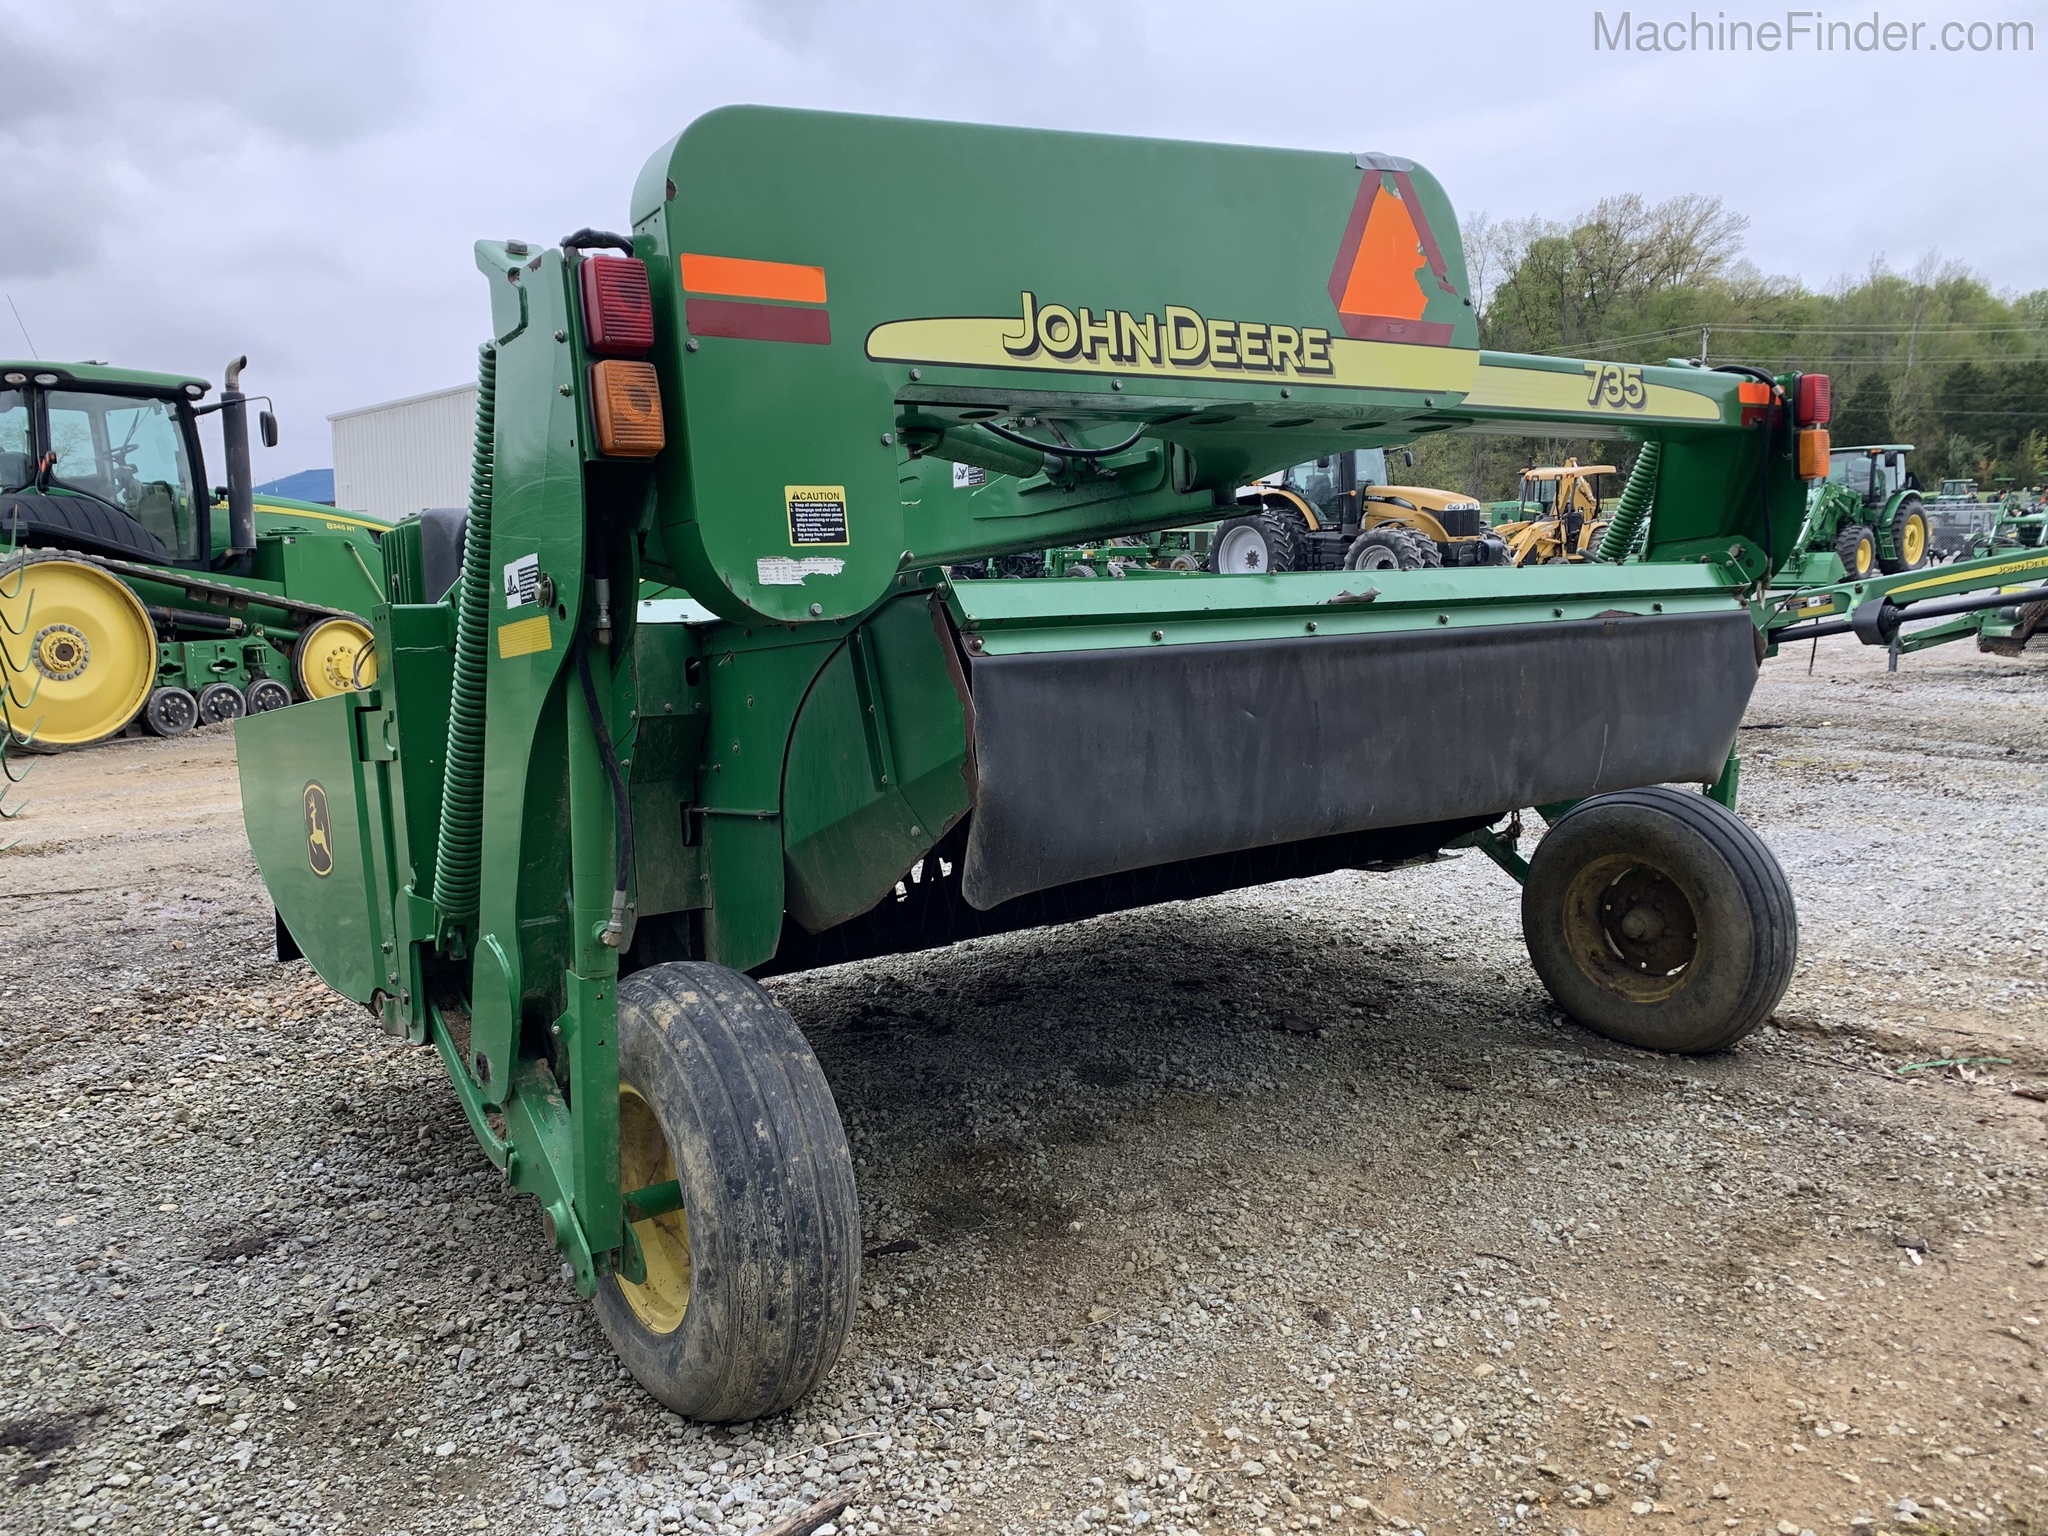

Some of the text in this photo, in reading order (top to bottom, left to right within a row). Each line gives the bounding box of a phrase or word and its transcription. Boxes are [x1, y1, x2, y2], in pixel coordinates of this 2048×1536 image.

[1002, 290, 1337, 379] JOHN DEERE
[1583, 363, 1648, 412] 735
[800, 492, 840, 501] CAUTION
[326, 522, 346, 531] 8345
[1998, 564, 2026, 575] JOHN
